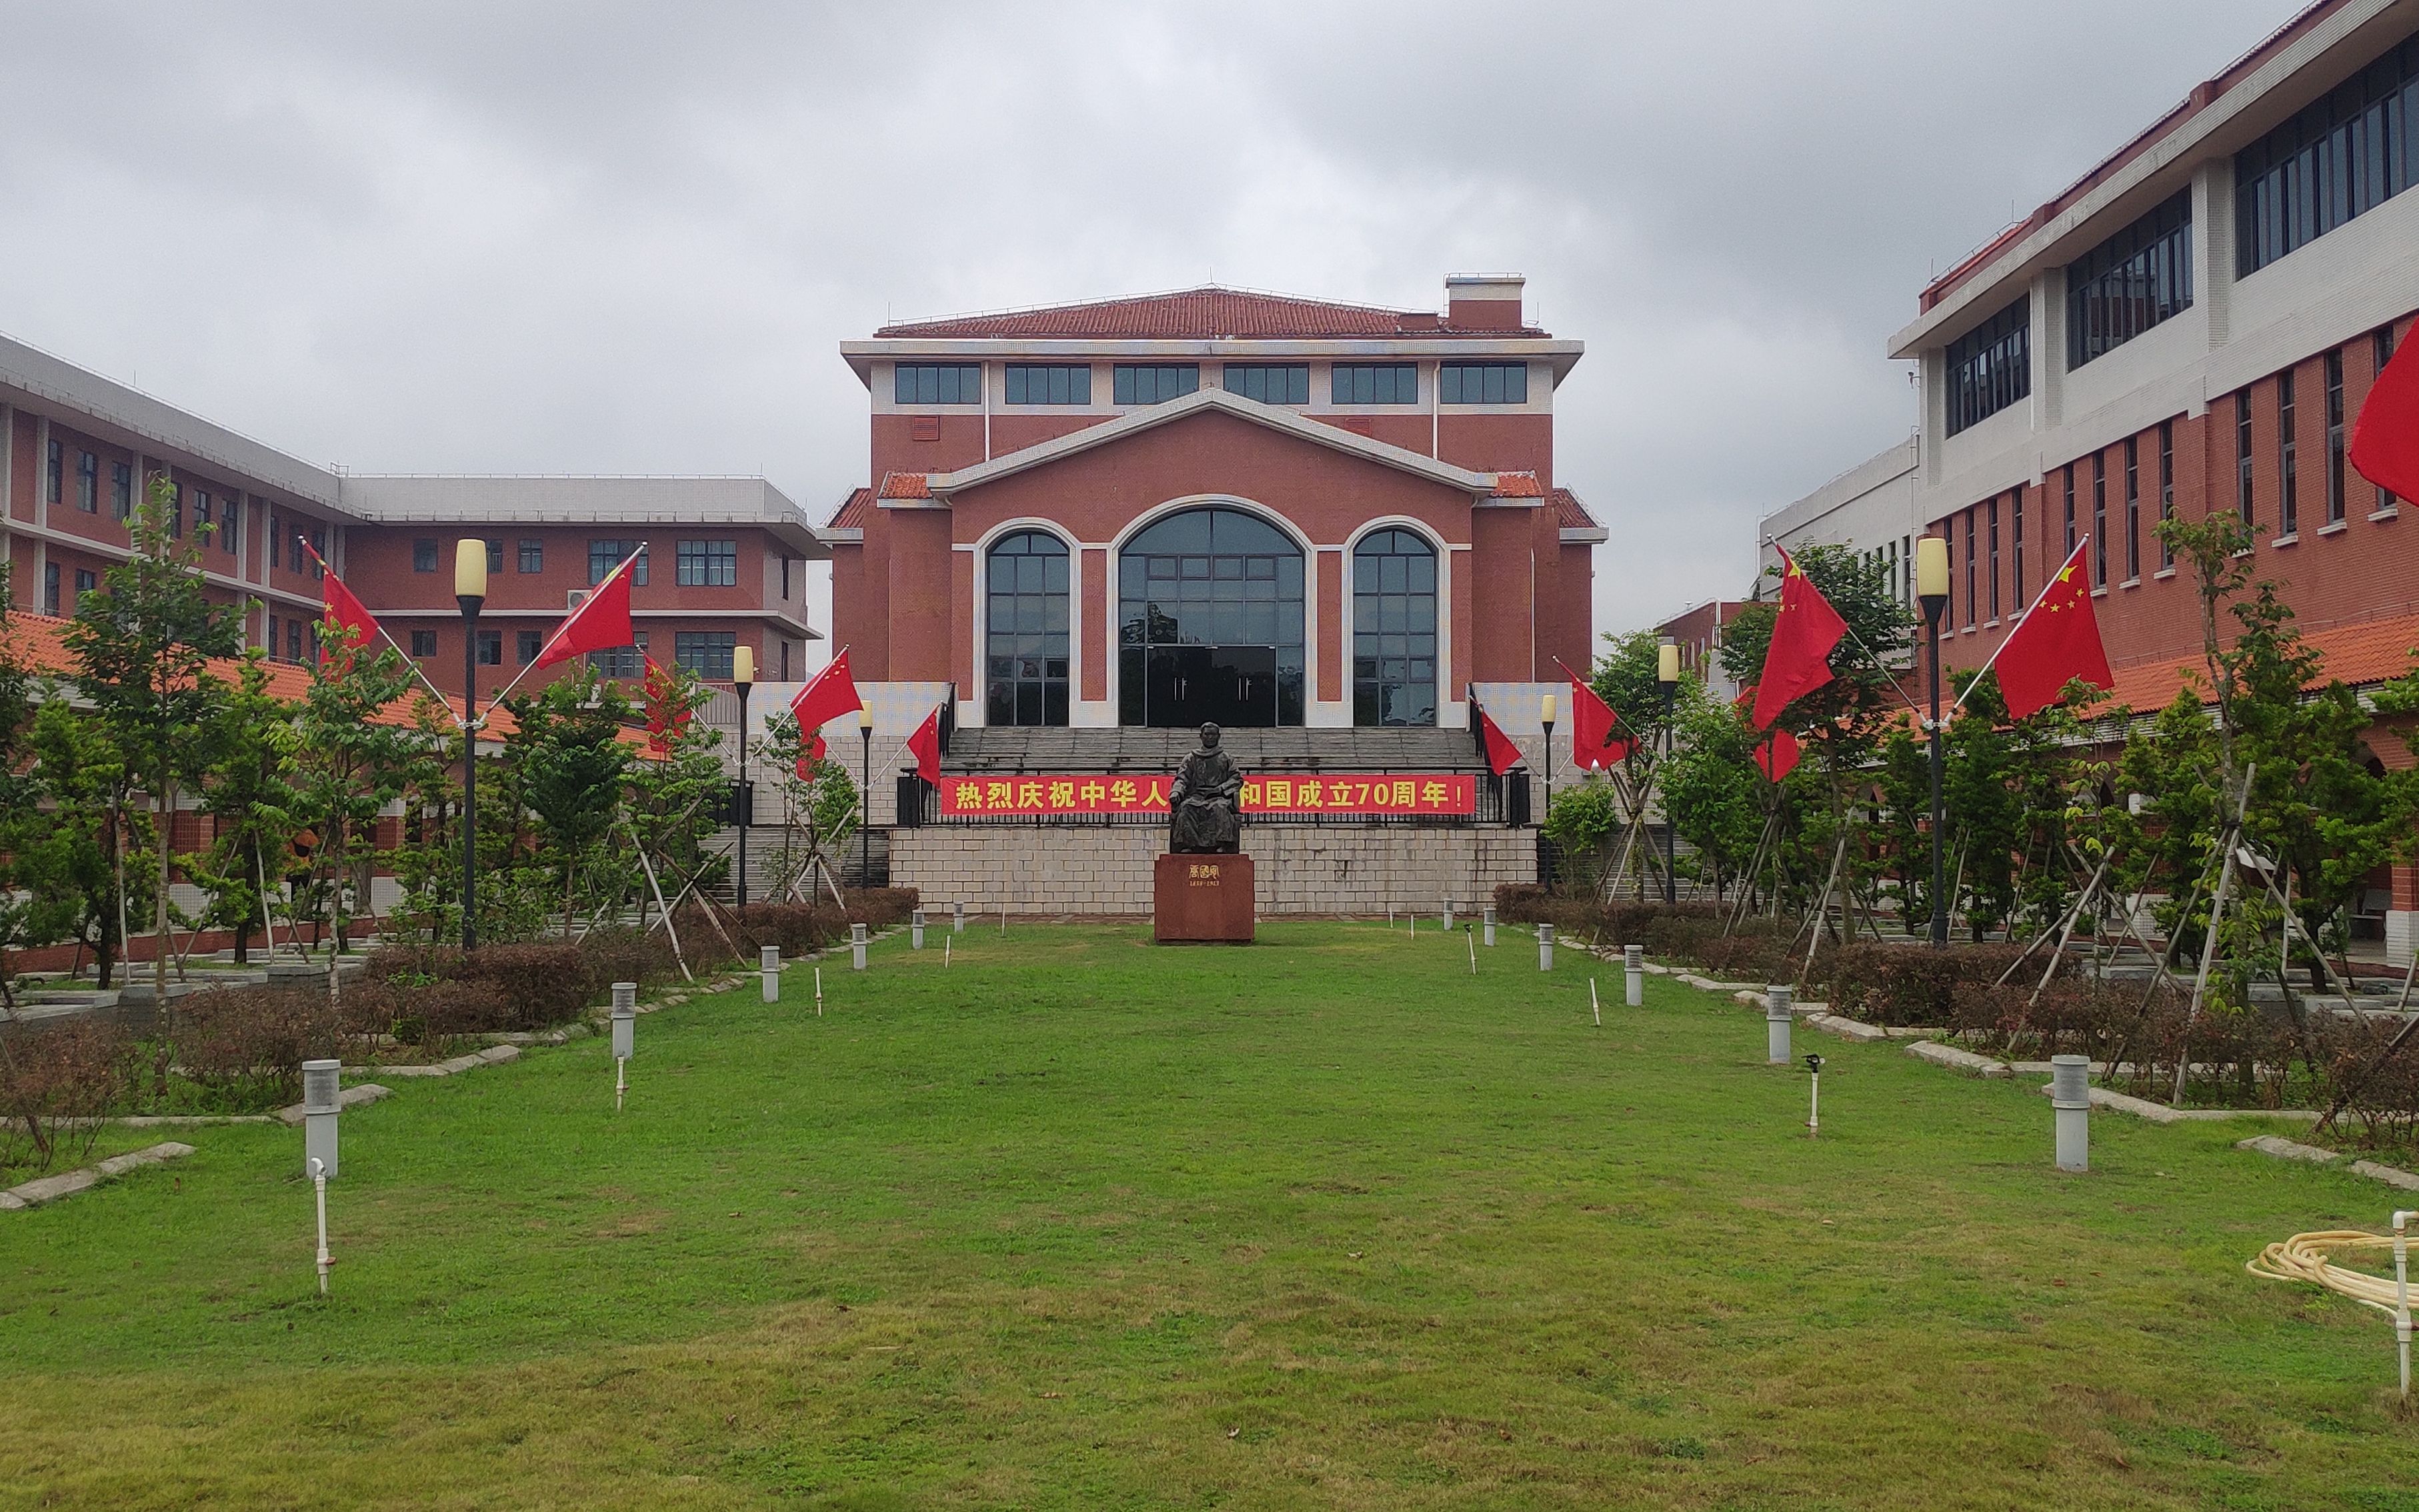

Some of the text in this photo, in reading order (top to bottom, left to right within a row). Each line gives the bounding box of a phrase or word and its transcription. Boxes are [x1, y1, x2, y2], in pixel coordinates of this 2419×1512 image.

[955, 779, 1462, 809] 热烈庆祝中华人和国成立70周年！
